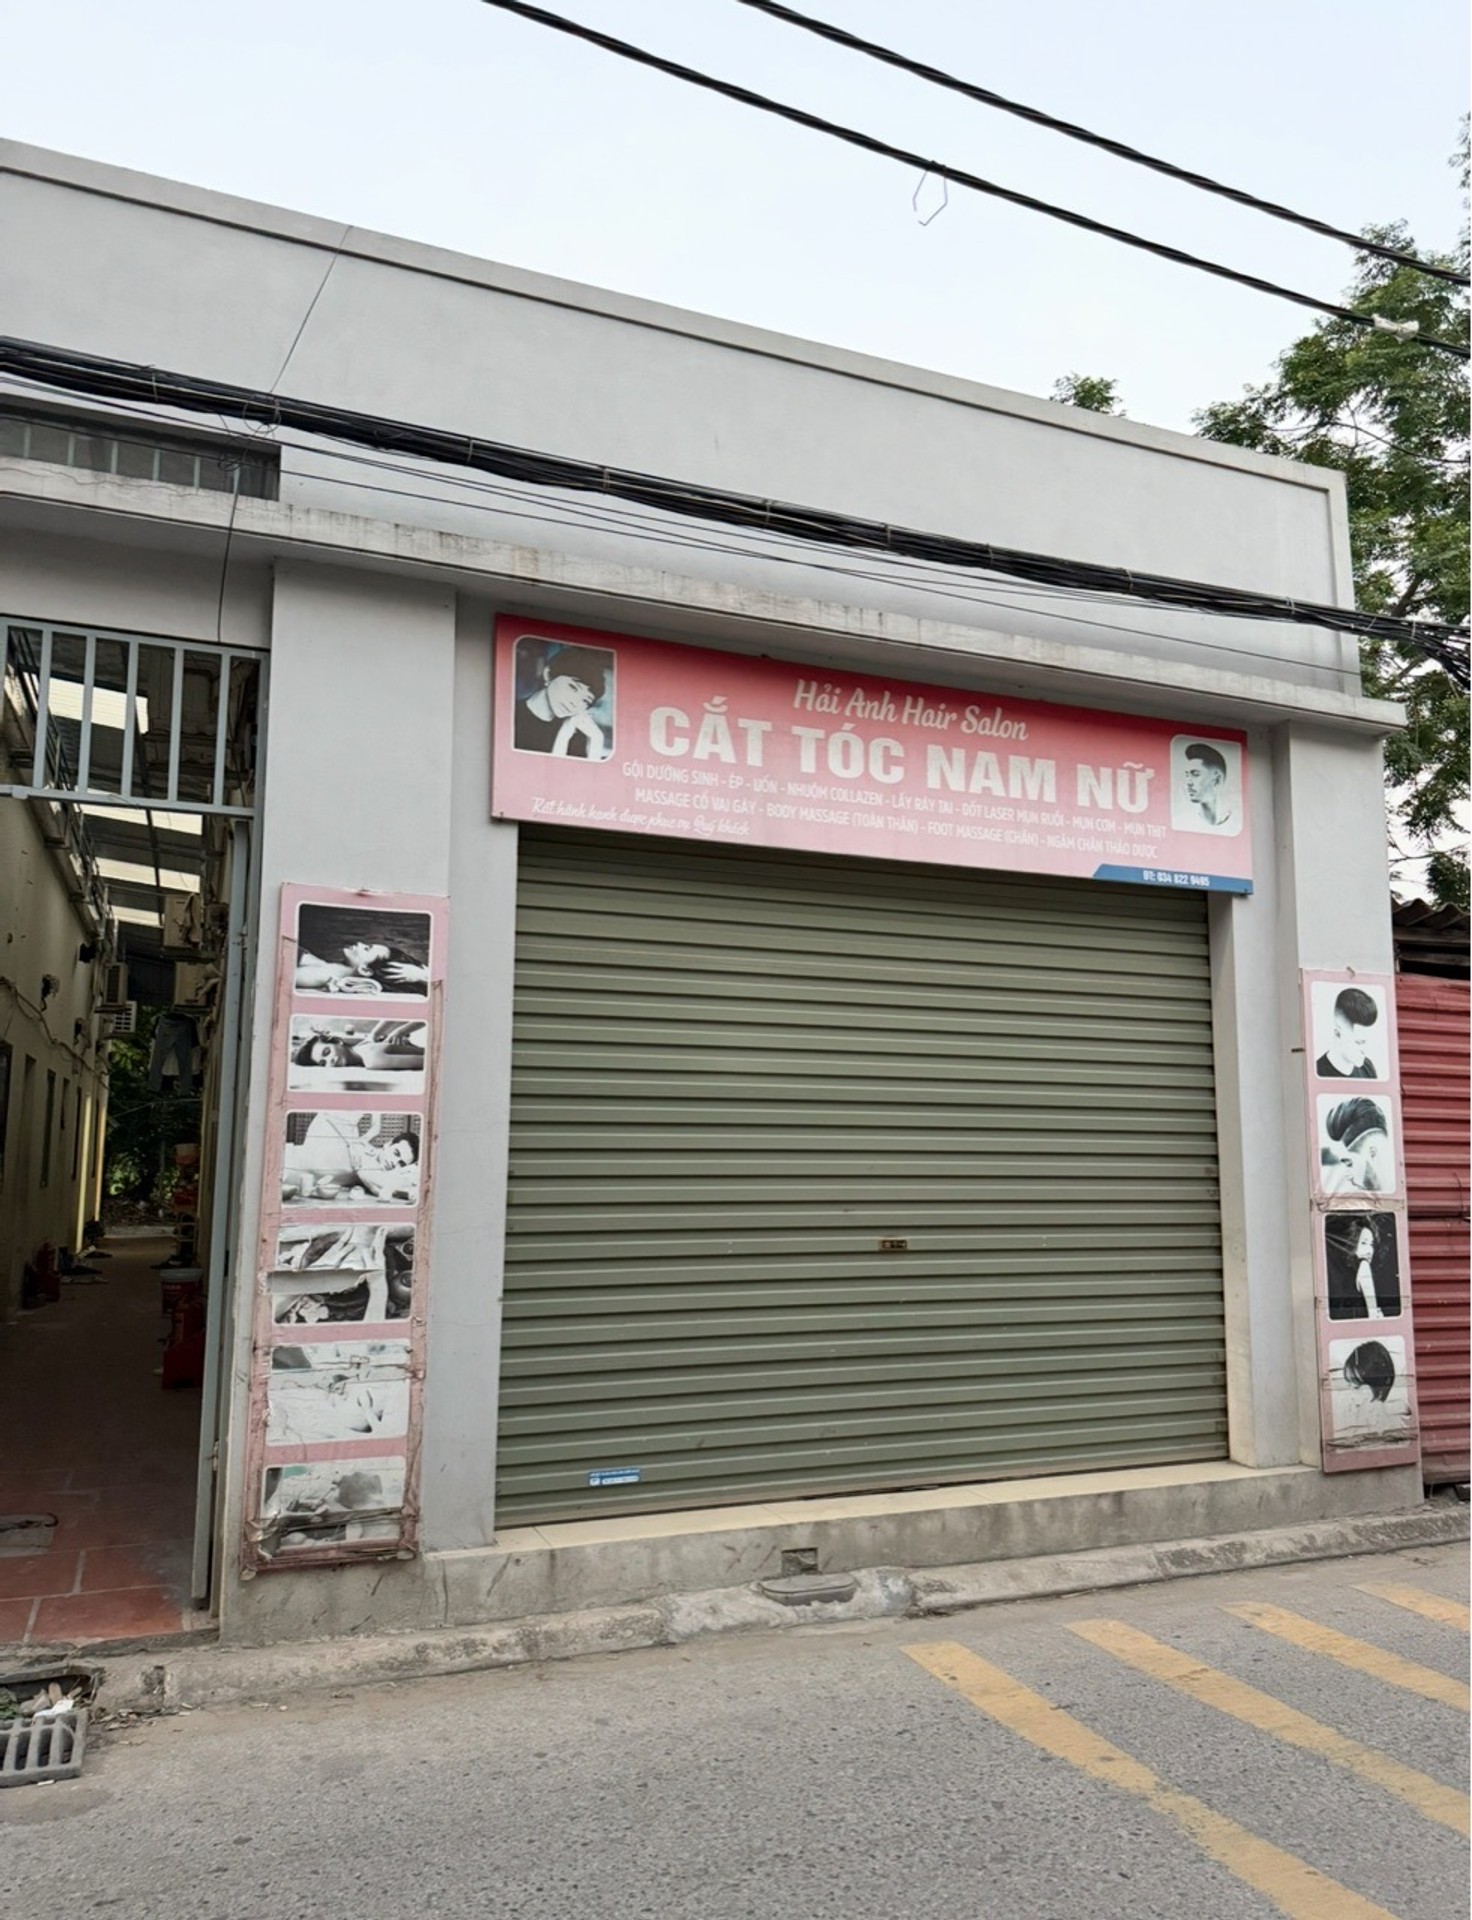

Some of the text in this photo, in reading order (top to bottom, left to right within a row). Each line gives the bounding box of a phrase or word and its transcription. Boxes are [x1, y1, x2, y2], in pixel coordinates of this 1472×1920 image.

[792, 678, 1029, 741] Hải Anh Hair Salon
[649, 696, 1155, 814] CẮT TÓC NAM NỮ
[635, 787, 690, 808] MASSAGE
[766, 803, 797, 820] BODY
[799, 807, 851, 825] MASSAGE
[927, 821, 954, 837] FOOT
[955, 825, 1003, 842] MASSAGE
[691, 769, 719, 787] SINH
[729, 772, 743, 789] ÉP
[984, 805, 1015, 821] LASER
